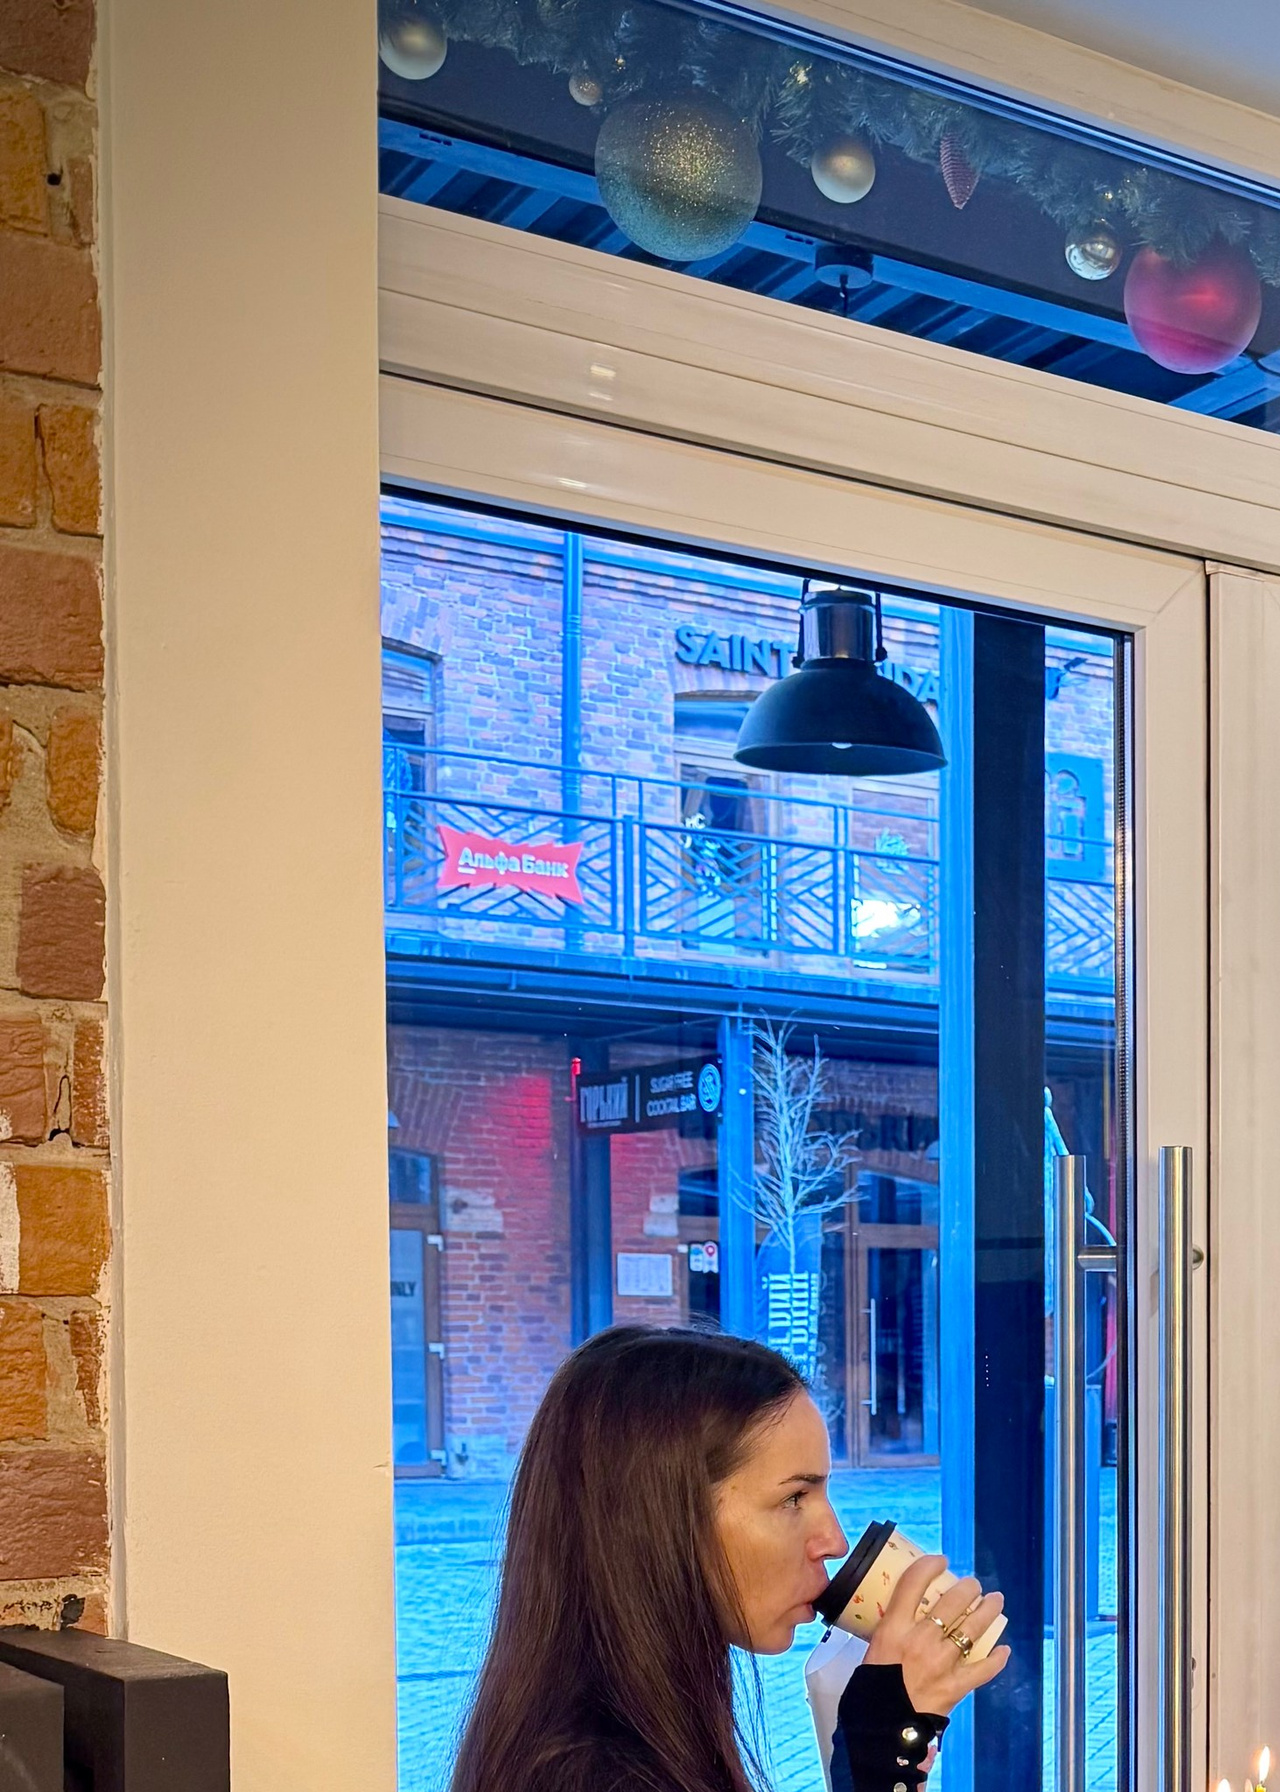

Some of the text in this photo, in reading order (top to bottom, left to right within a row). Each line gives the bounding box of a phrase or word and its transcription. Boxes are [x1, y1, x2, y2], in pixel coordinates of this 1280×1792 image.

[674, 624, 798, 680] SAINT
[457, 846, 569, 878] Альфа Банк
